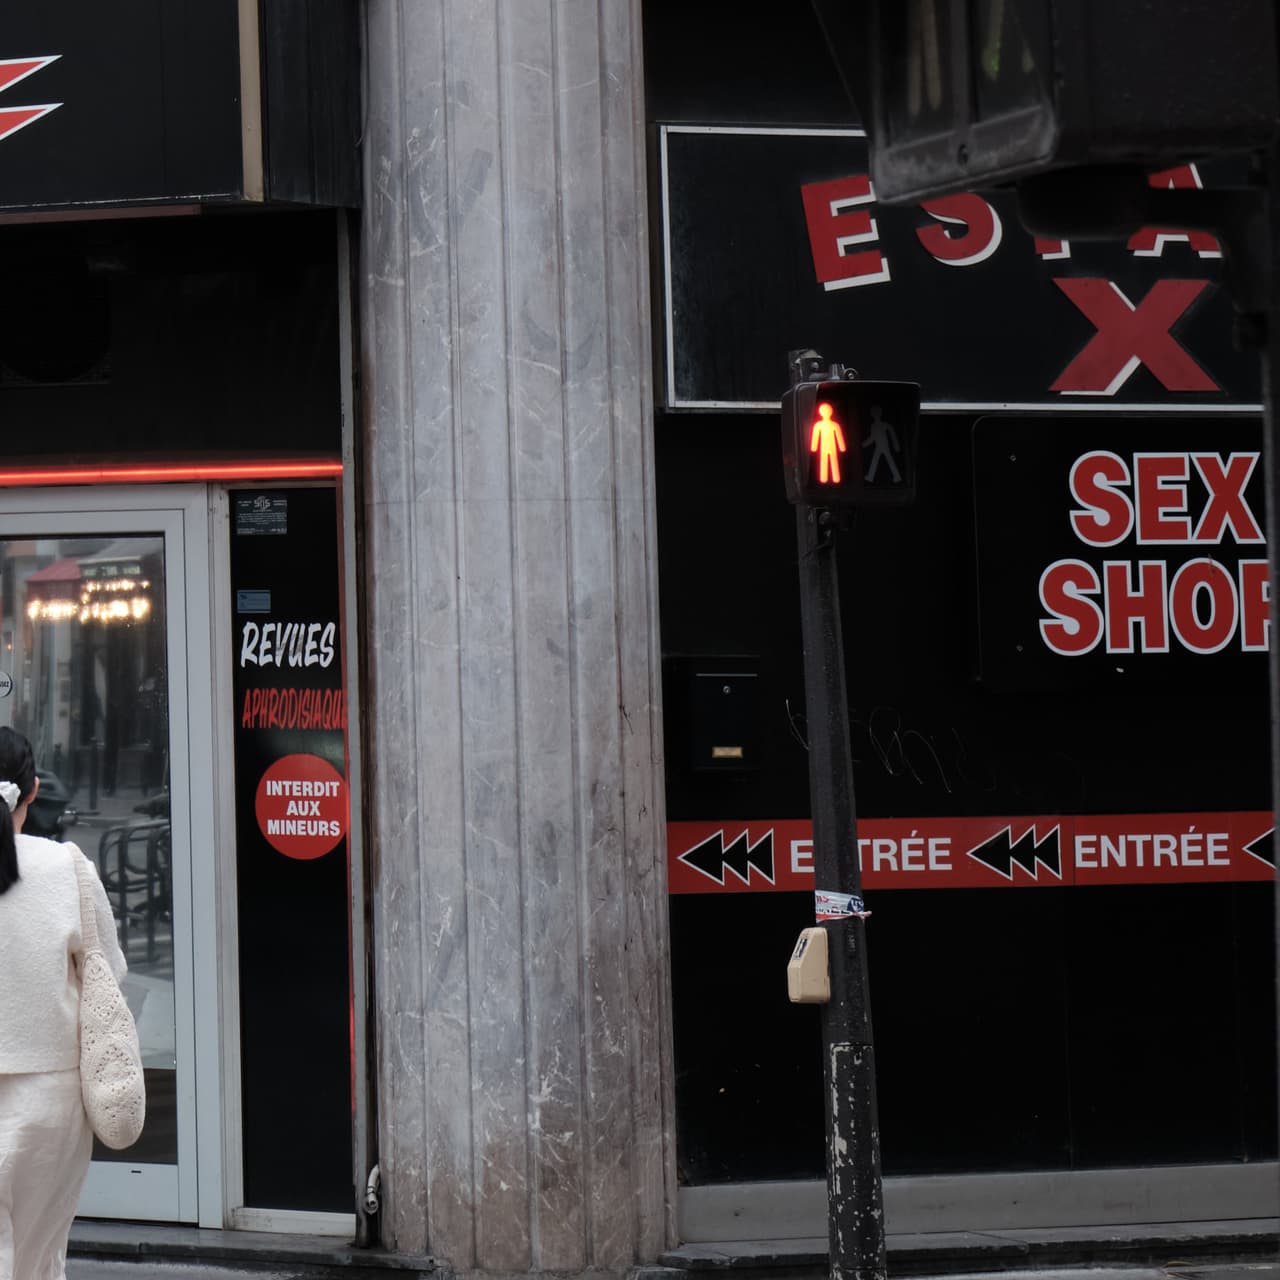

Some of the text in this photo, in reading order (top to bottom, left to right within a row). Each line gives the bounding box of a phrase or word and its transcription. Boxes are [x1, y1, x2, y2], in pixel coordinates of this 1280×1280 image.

[800, 162, 1223, 292] ESA
[1047, 278, 1223, 396] X
[1069, 450, 1266, 548] SEX
[240, 621, 336, 668] REVUES
[266, 780, 340, 797] INTERDIT
[286, 800, 321, 816] AUX
[267, 819, 340, 836] MINEURS
[790, 826, 1231, 873] ETRÉE ENTRÉE
